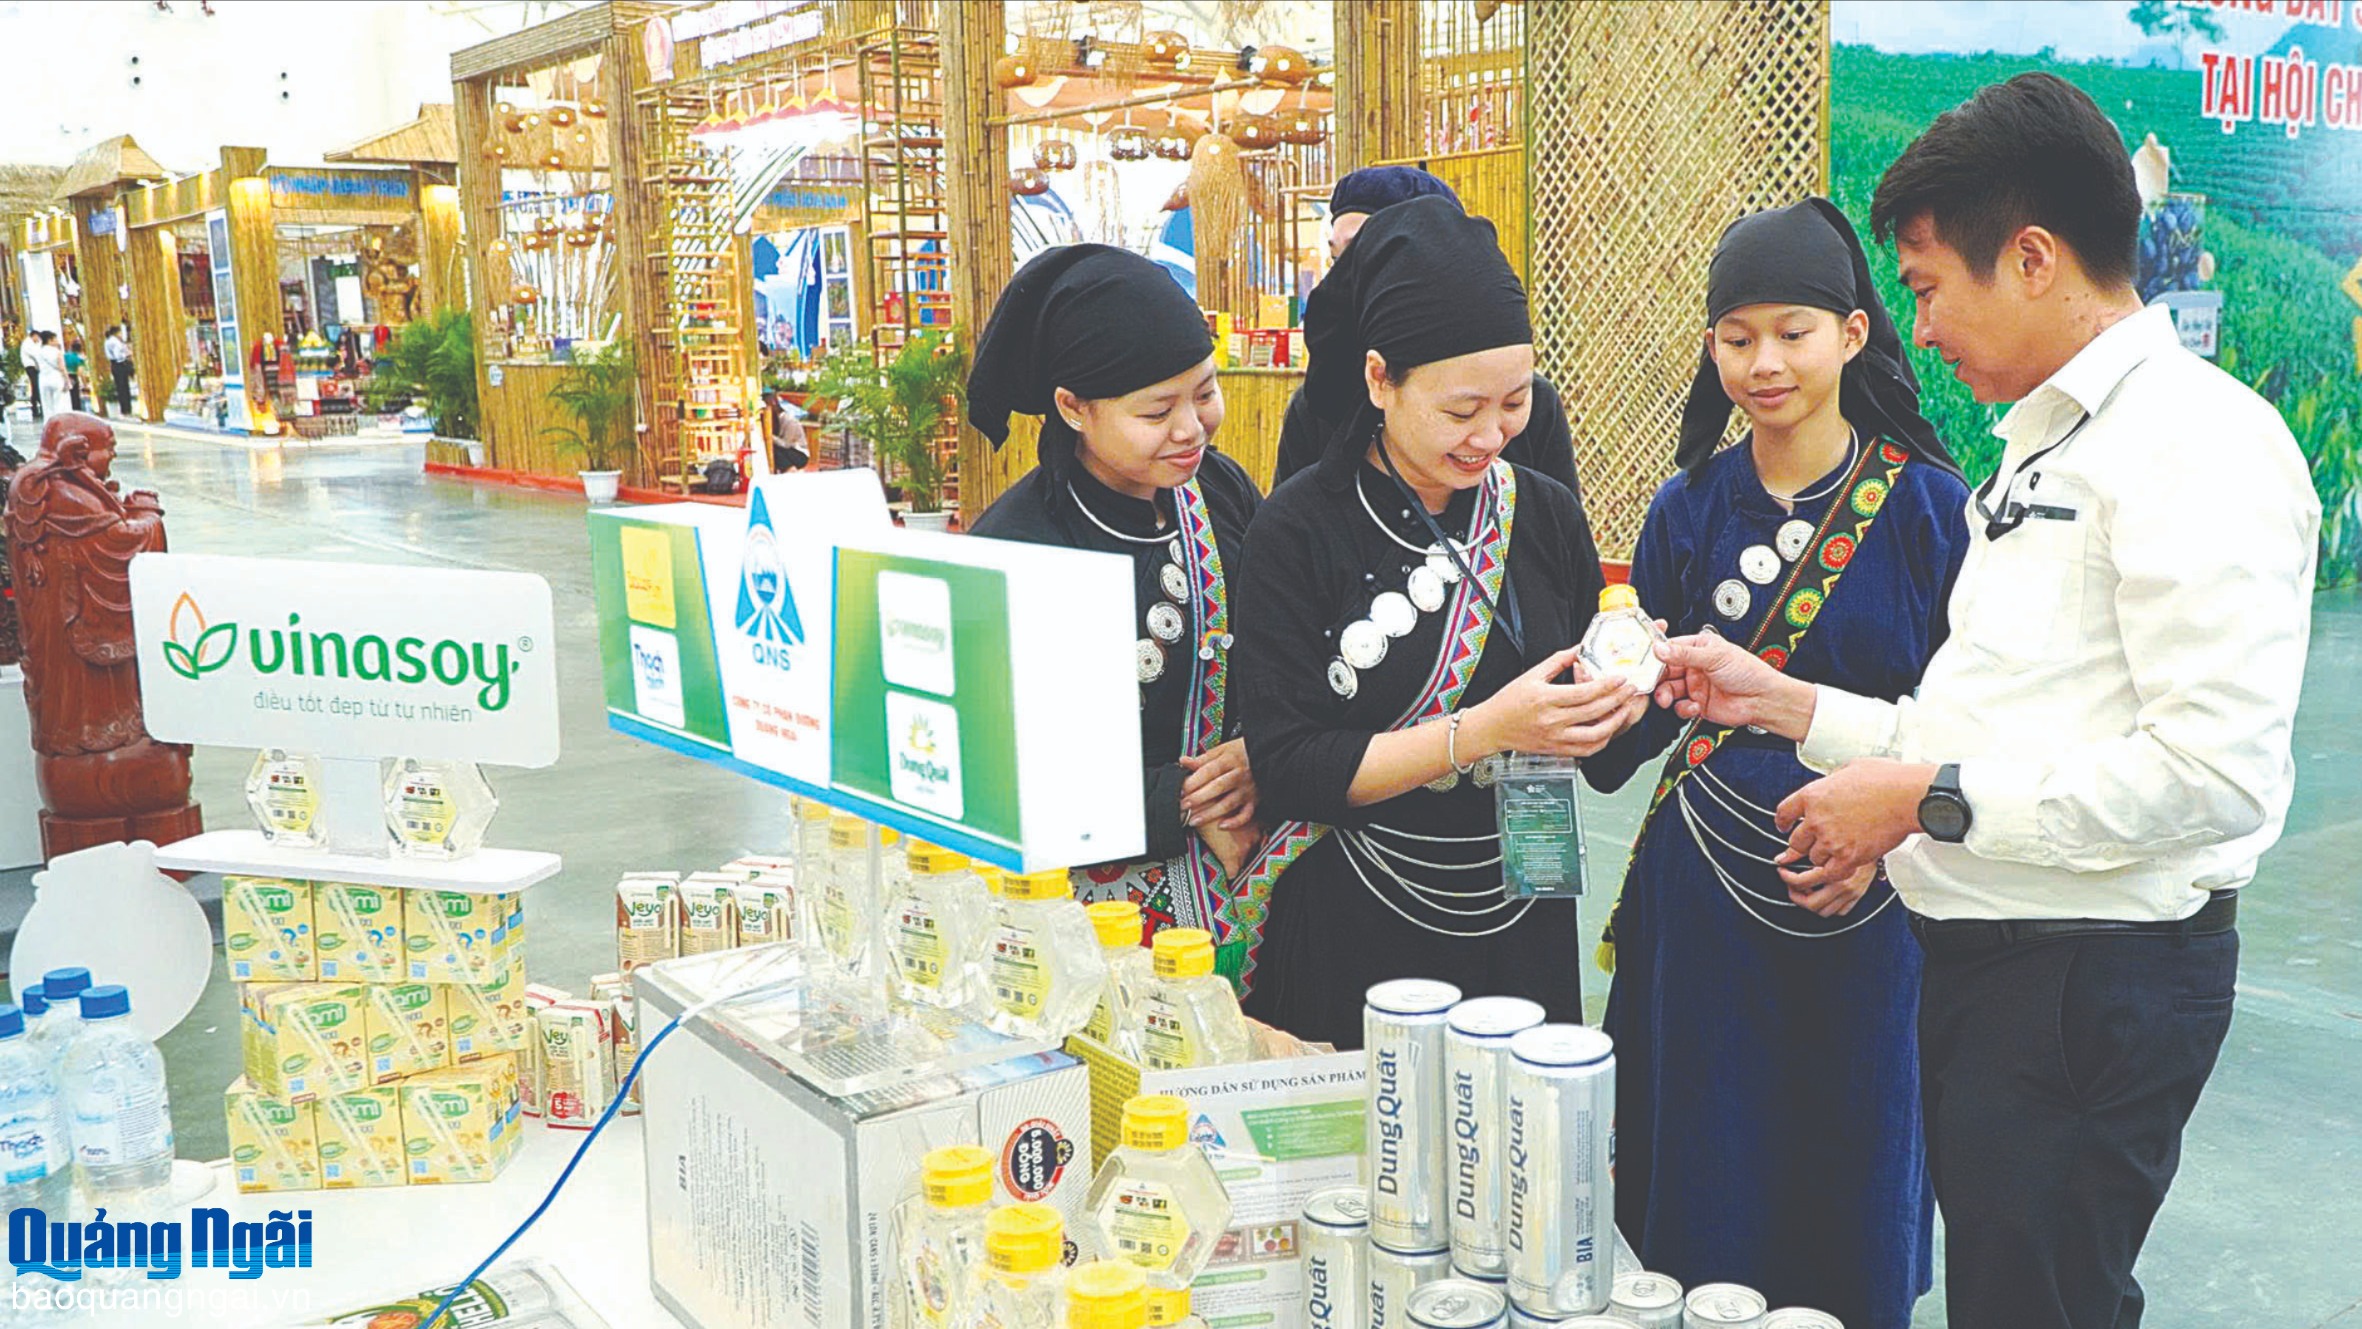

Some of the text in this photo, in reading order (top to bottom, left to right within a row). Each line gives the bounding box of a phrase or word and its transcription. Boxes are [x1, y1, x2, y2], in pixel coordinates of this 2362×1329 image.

[2203, 53, 2251, 129] TẠI
[2263, 50, 2315, 134] HỘI
[752, 642, 791, 671] QNS
[421, 702, 472, 722] nhiên
[624, 902, 663, 917] Veyo
[684, 902, 721, 917] Veyo
[1576, 1236, 1593, 1264] BIA
